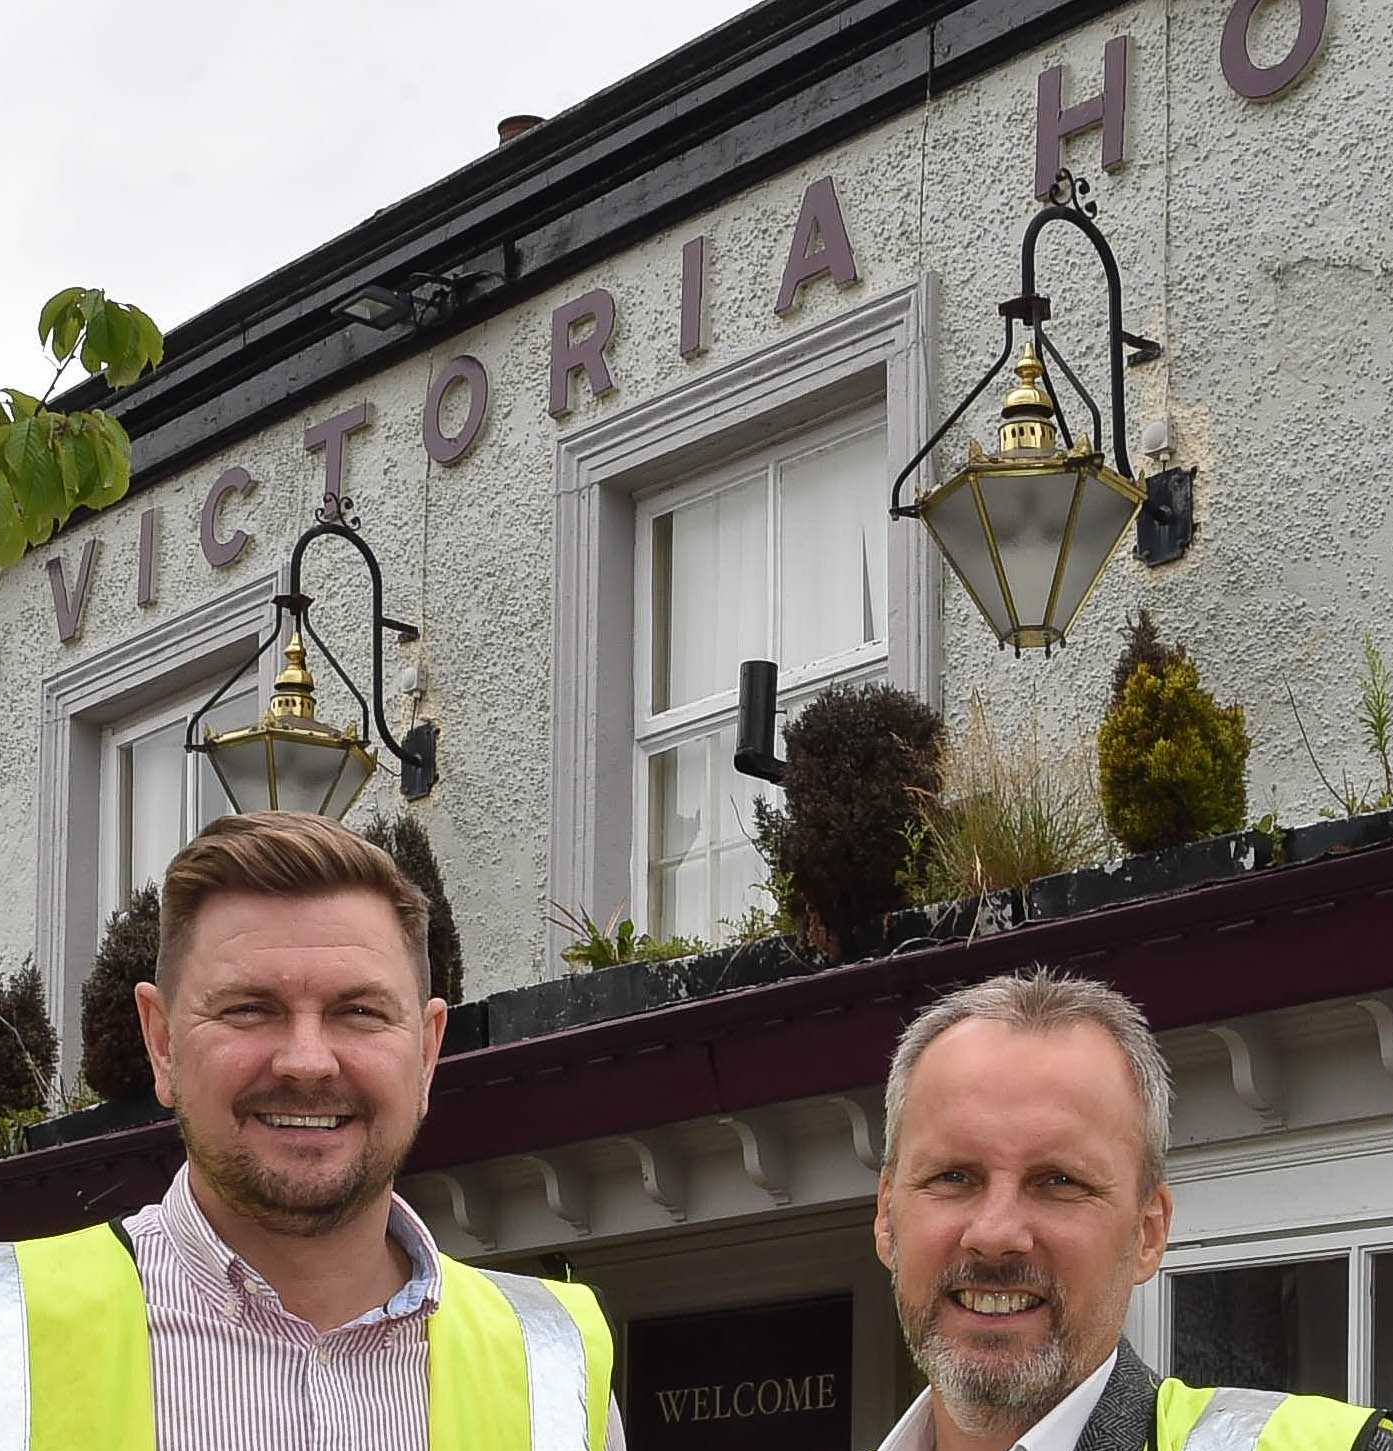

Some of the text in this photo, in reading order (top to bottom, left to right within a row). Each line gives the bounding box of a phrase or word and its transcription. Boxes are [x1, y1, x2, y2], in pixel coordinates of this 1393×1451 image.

[45, 0, 1328, 645] VICTORIA HO
[655, 1373, 838, 1425] WELCOME
